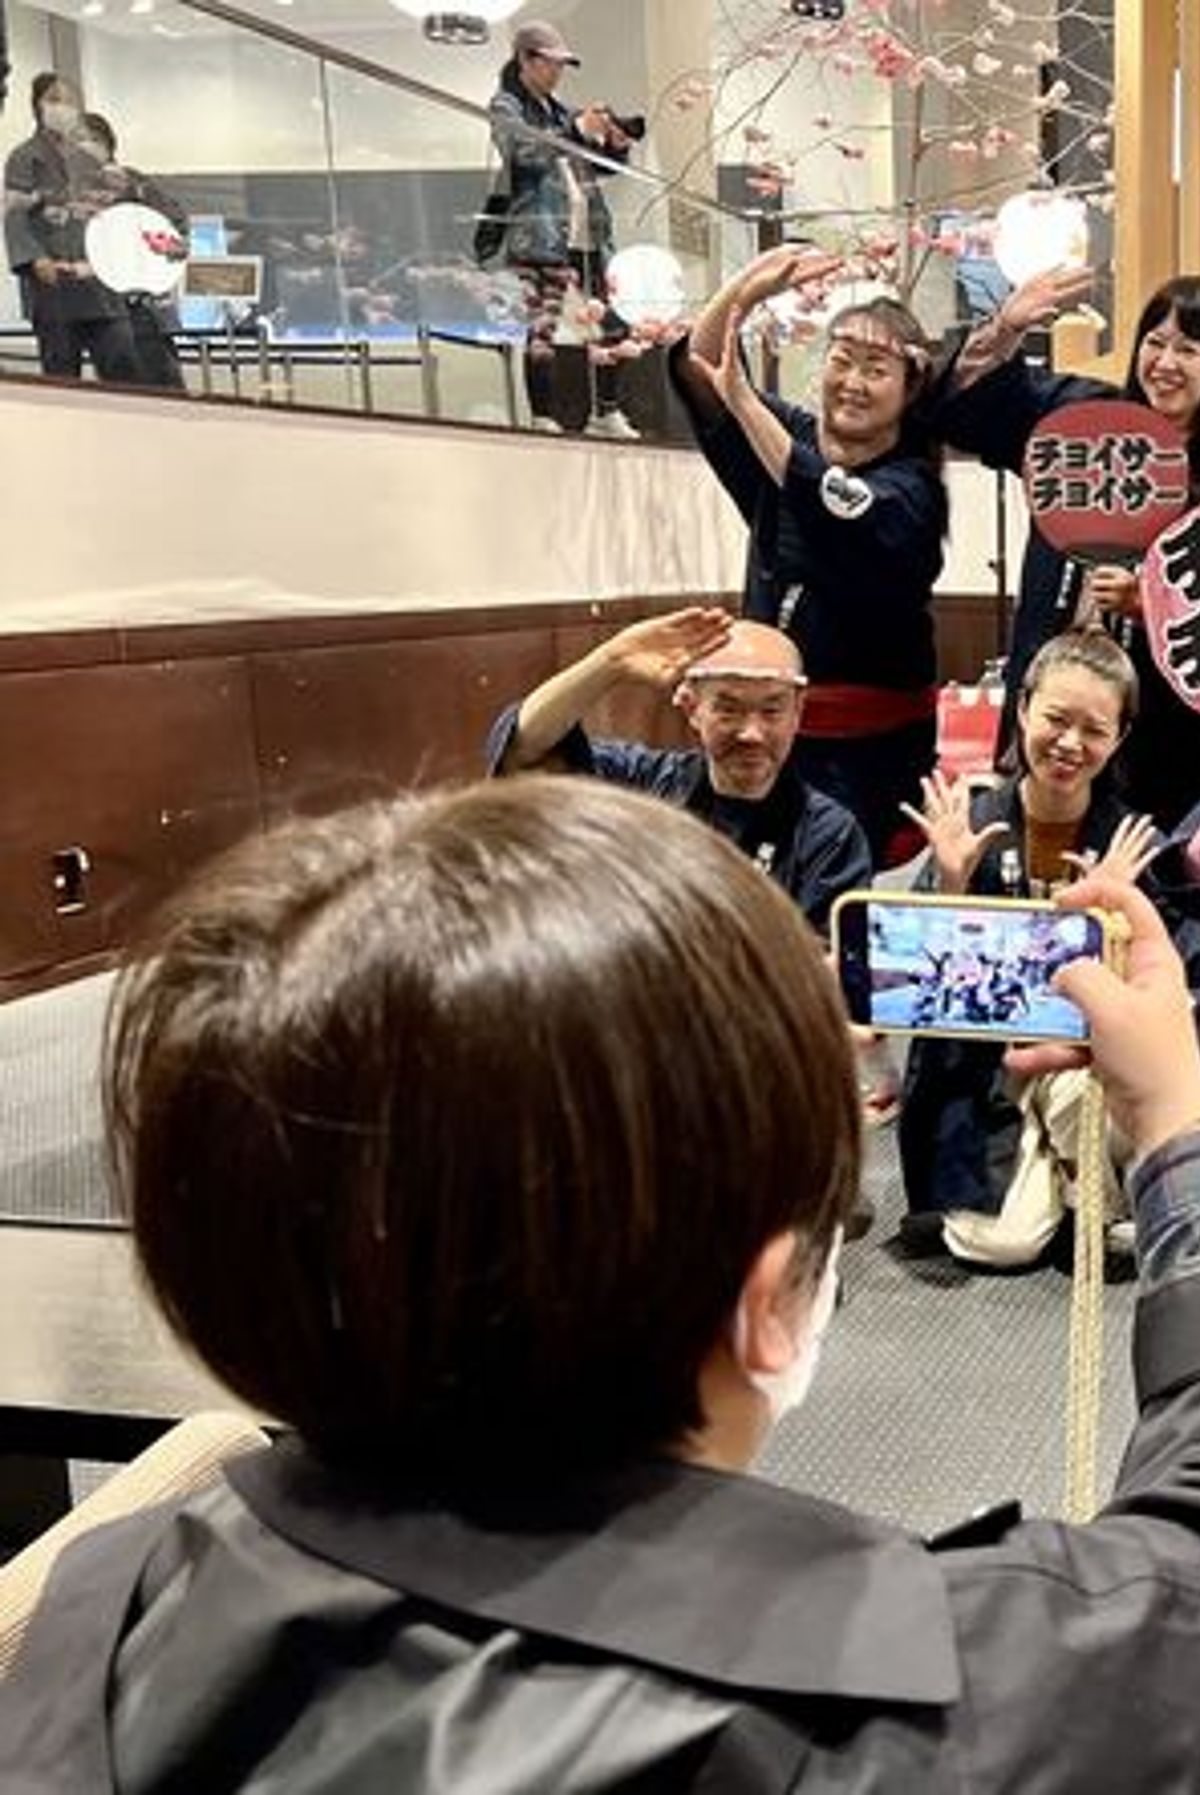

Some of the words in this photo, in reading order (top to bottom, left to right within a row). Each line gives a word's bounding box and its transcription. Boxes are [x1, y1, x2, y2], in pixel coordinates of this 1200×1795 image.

[1031, 436, 1185, 473] チョイサー
[1032, 476, 1185, 512] チョイサー
